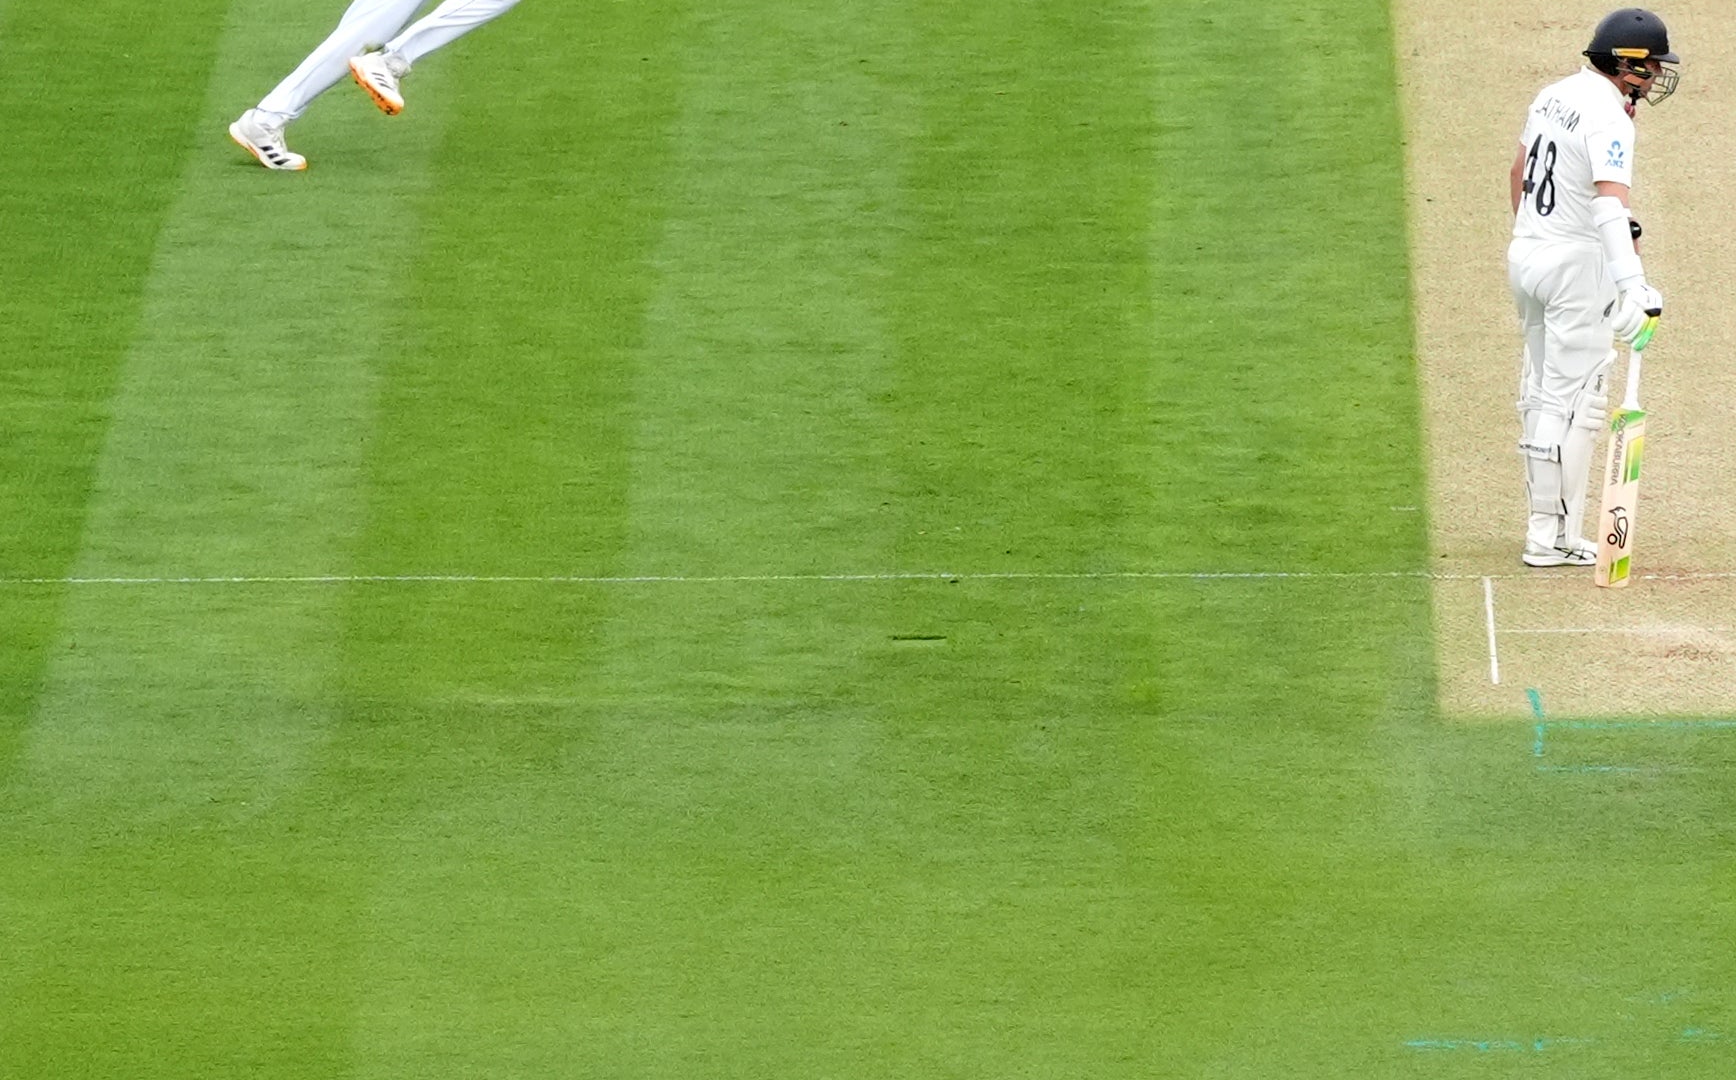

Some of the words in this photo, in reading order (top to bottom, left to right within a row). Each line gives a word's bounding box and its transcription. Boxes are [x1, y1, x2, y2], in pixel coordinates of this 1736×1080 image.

[1535, 96, 1581, 133] ATHAM
[1521, 133, 1557, 217] 48
[1604, 159, 1625, 169] ANZ
[1609, 413, 1627, 487] KOOKABURRA
